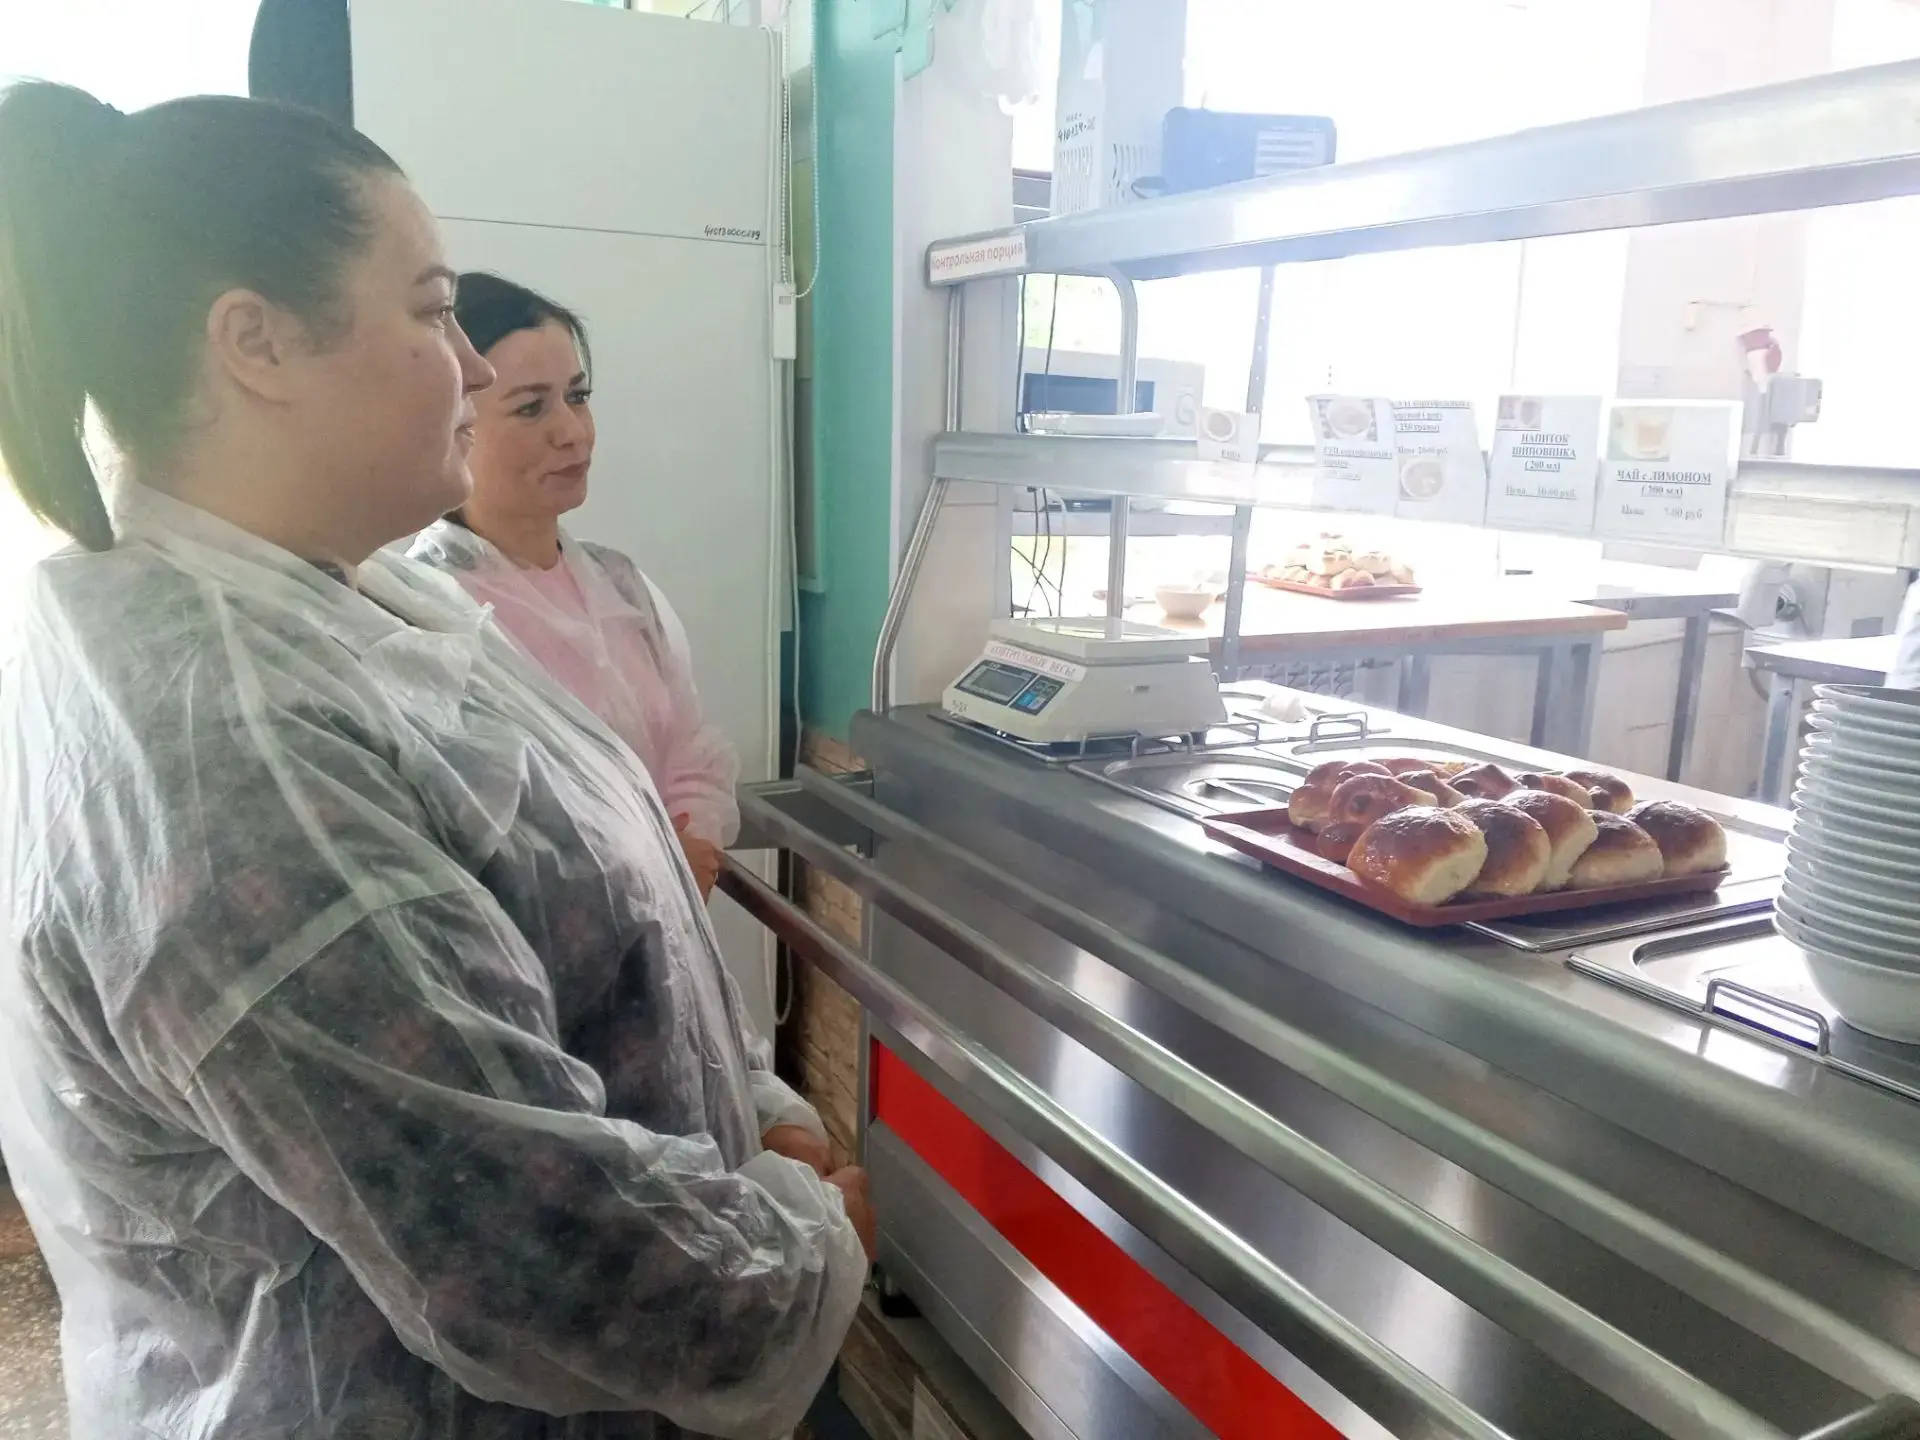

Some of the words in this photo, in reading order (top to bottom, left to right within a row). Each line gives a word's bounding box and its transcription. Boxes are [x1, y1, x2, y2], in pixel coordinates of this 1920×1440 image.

[987, 242, 1024, 262] порция
[1521, 433, 1570, 444] НАПИТОК
[1512, 446, 1576, 458] ШИПОВНИКА
[1617, 469, 1640, 481] ЧАЙ
[1649, 471, 1711, 483] ЛИМОНОМ
